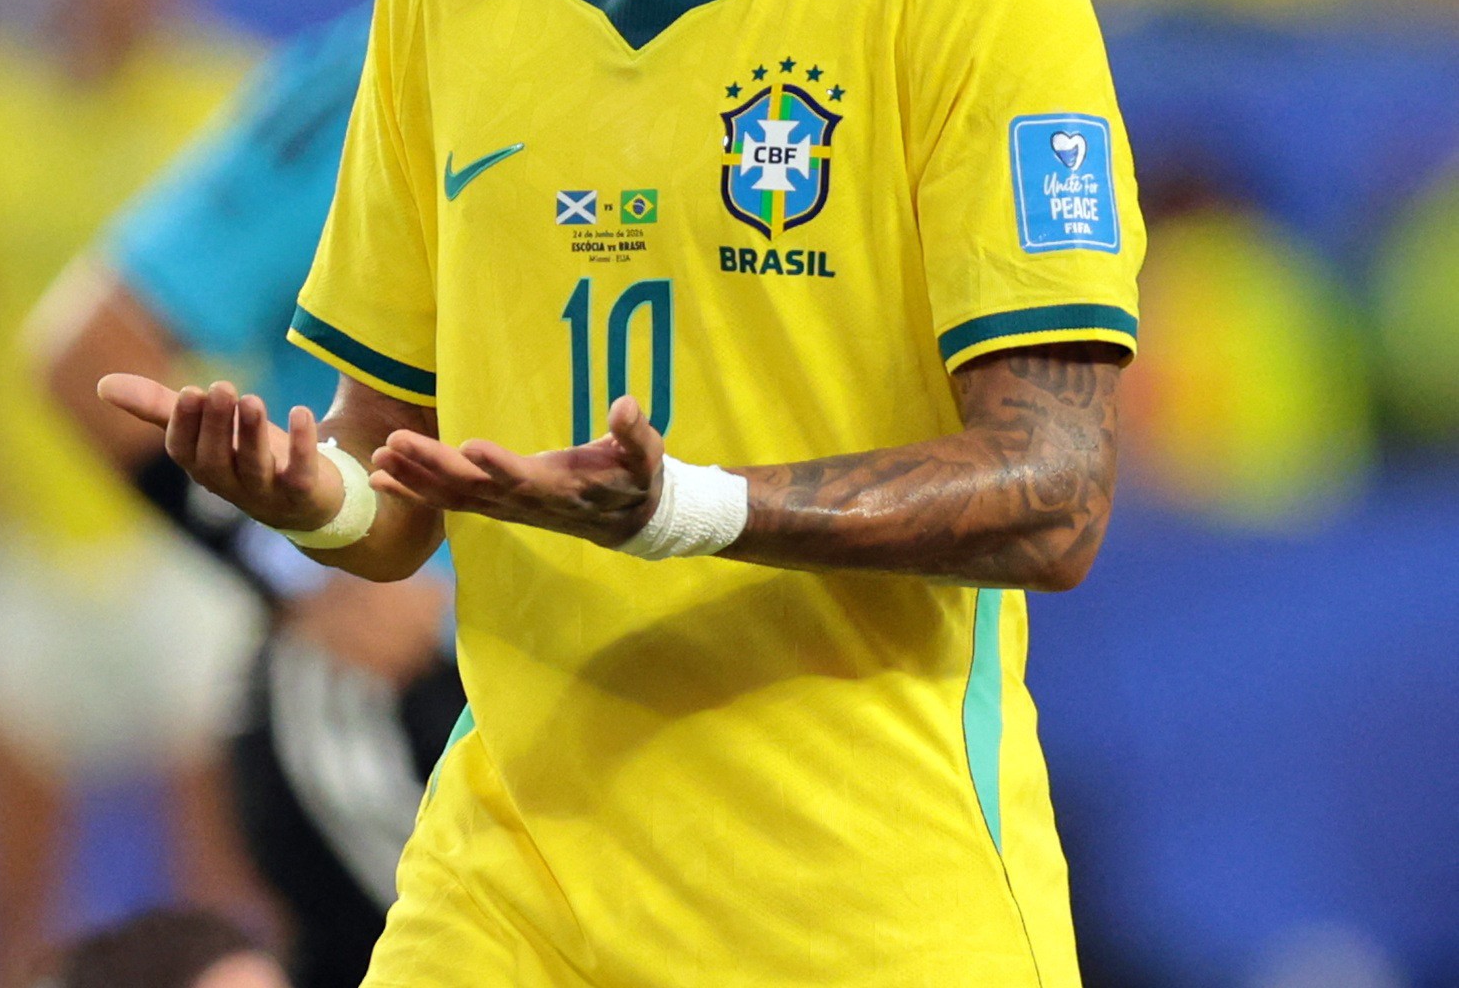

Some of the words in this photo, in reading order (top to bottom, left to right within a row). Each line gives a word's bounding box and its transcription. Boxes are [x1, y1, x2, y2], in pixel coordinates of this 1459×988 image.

[753, 146, 798, 165] CBF
[1043, 172, 1082, 197] Unite
[1050, 196, 1100, 221] PEACE
[573, 230, 582, 238] 24
[584, 230, 593, 238] de
[616, 230, 624, 238] de
[626, 229, 644, 237] 2026
[1064, 222, 1093, 234] FIFA
[571, 240, 605, 252] ESCÓCIA
[619, 241, 647, 251] BRASIL
[616, 254, 631, 262] EUA
[719, 245, 836, 278] BRASIL
[560, 276, 675, 446] 10
